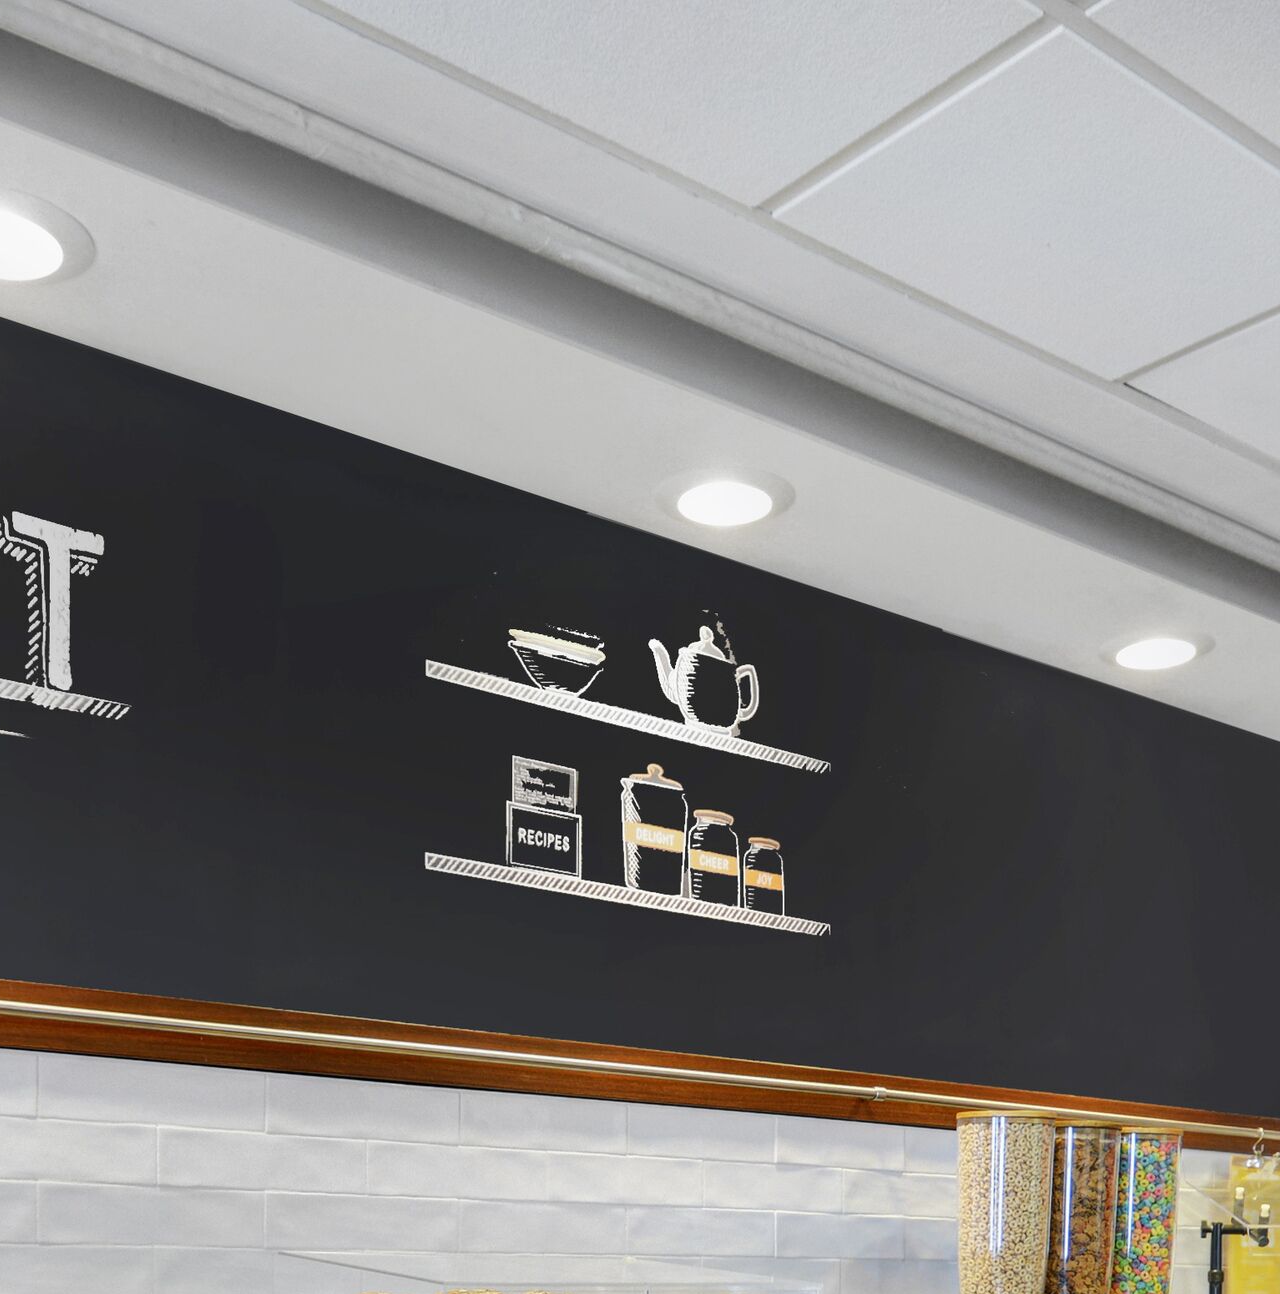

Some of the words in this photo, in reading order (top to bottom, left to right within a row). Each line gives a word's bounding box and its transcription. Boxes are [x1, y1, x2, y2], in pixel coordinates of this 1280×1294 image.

[518, 827, 570, 853] RECIPES
[635, 828, 676, 847] DELIGHT
[699, 853, 729, 871] CHEER
[756, 873, 773, 886] JOY
